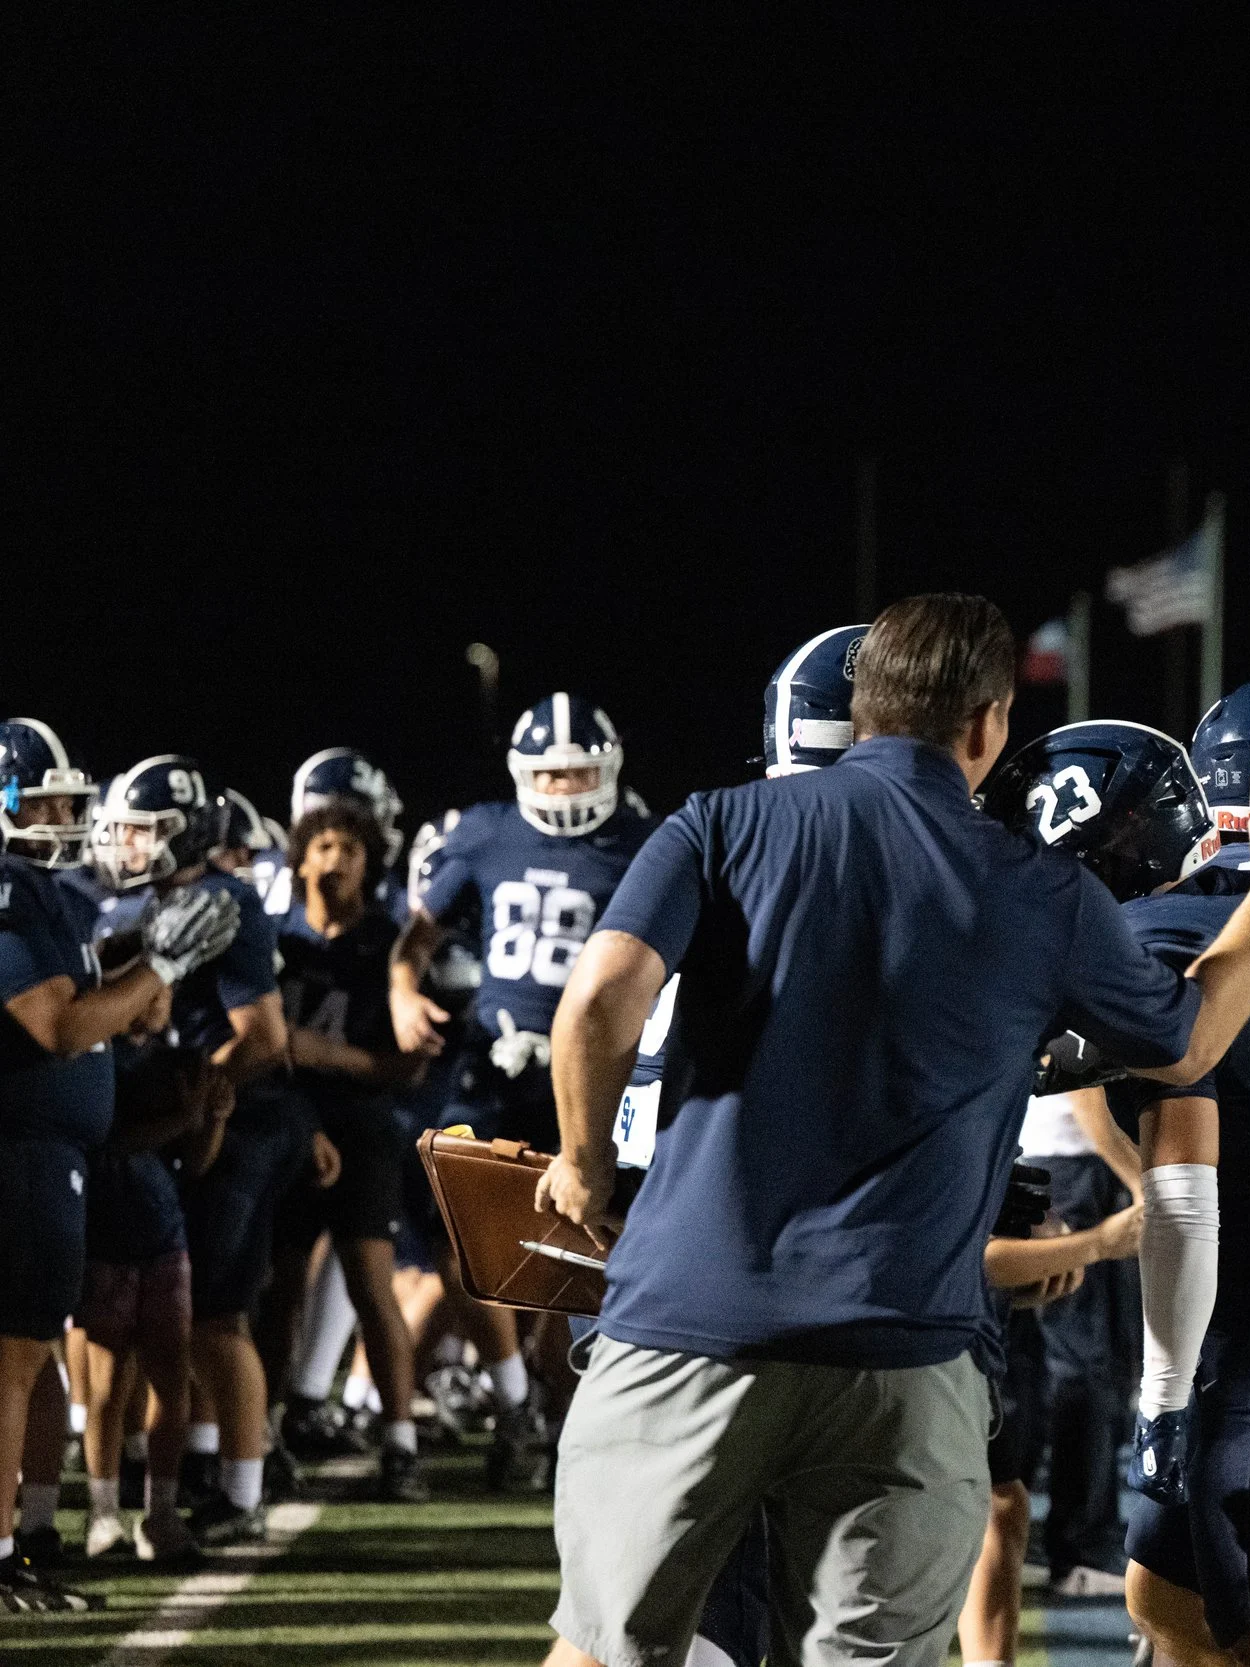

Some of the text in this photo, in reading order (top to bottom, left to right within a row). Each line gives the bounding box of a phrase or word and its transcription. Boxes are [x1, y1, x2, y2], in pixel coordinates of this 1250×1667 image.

[168, 769, 206, 807] 91
[1026, 765, 1101, 845] 23
[487, 881, 596, 985] 88
[621, 1096, 635, 1142] SV
